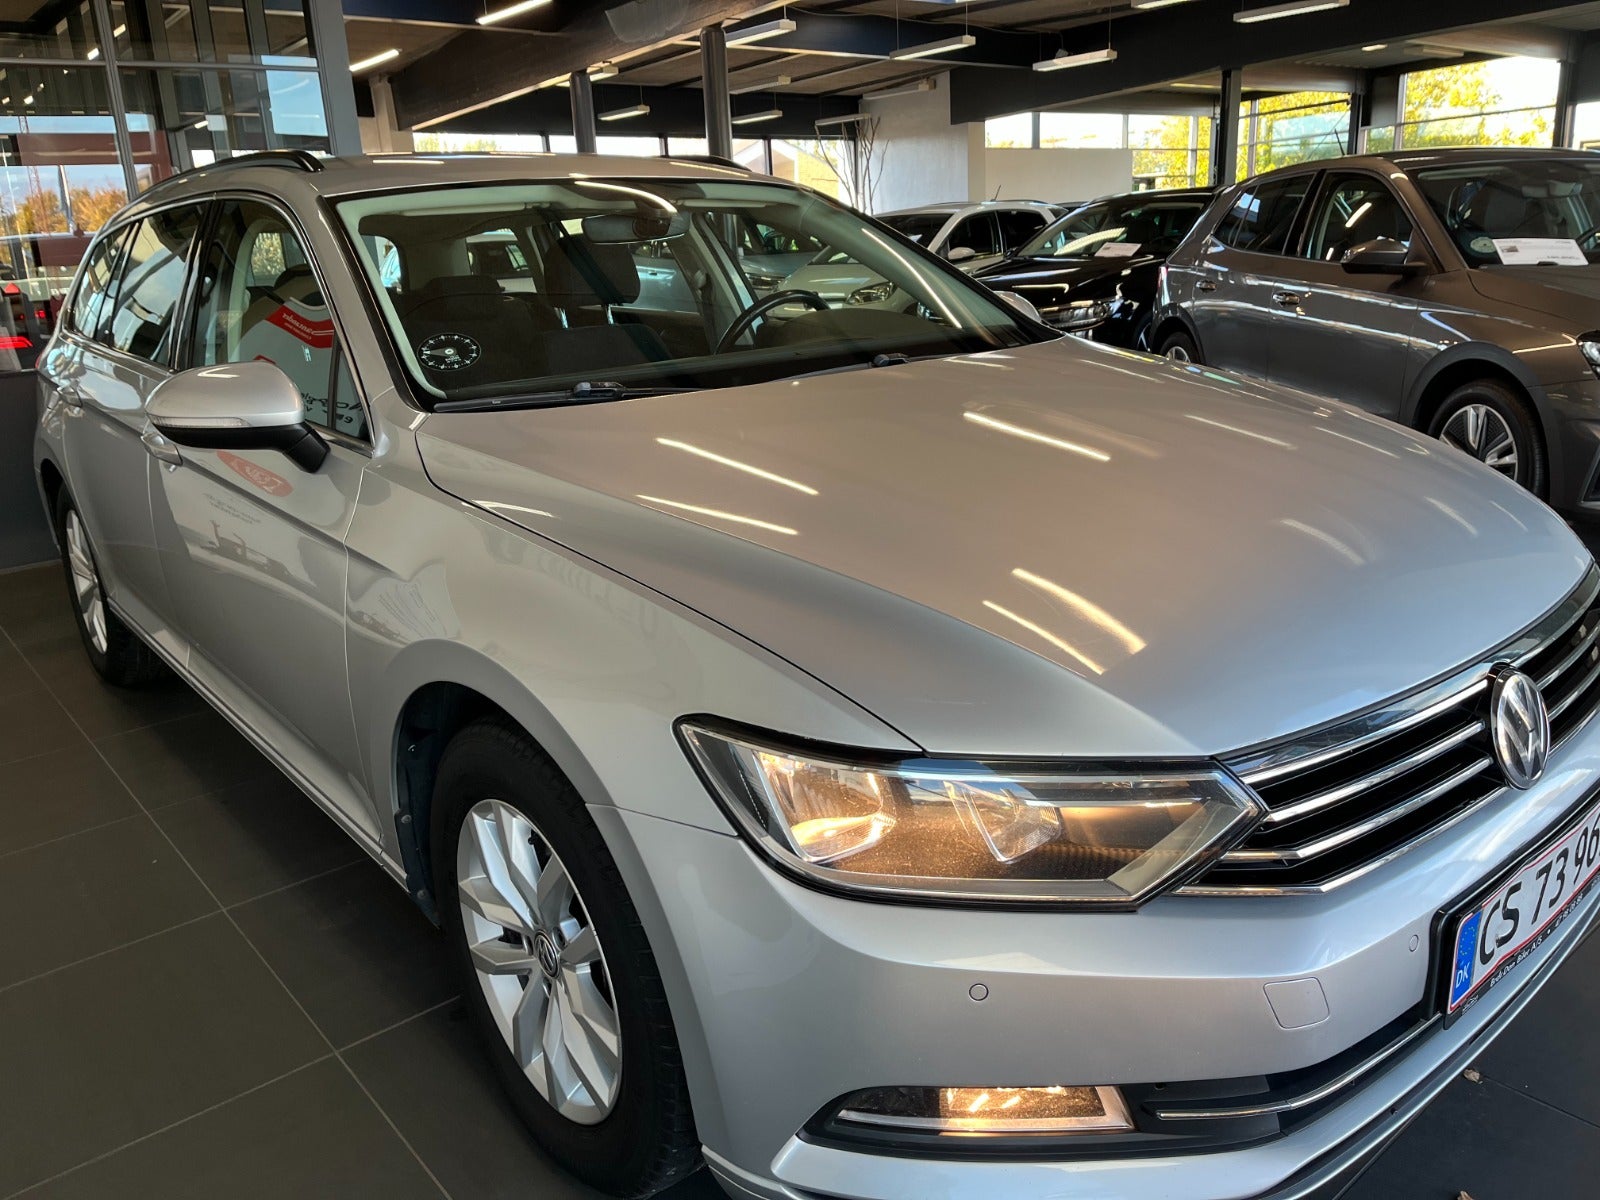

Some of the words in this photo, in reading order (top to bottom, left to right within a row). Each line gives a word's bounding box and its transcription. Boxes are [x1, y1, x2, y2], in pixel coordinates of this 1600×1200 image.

[1480, 881, 1522, 966] CS
[1531, 847, 1569, 925] 73
[1573, 813, 1600, 886] 96
[1455, 963, 1471, 989] DK
